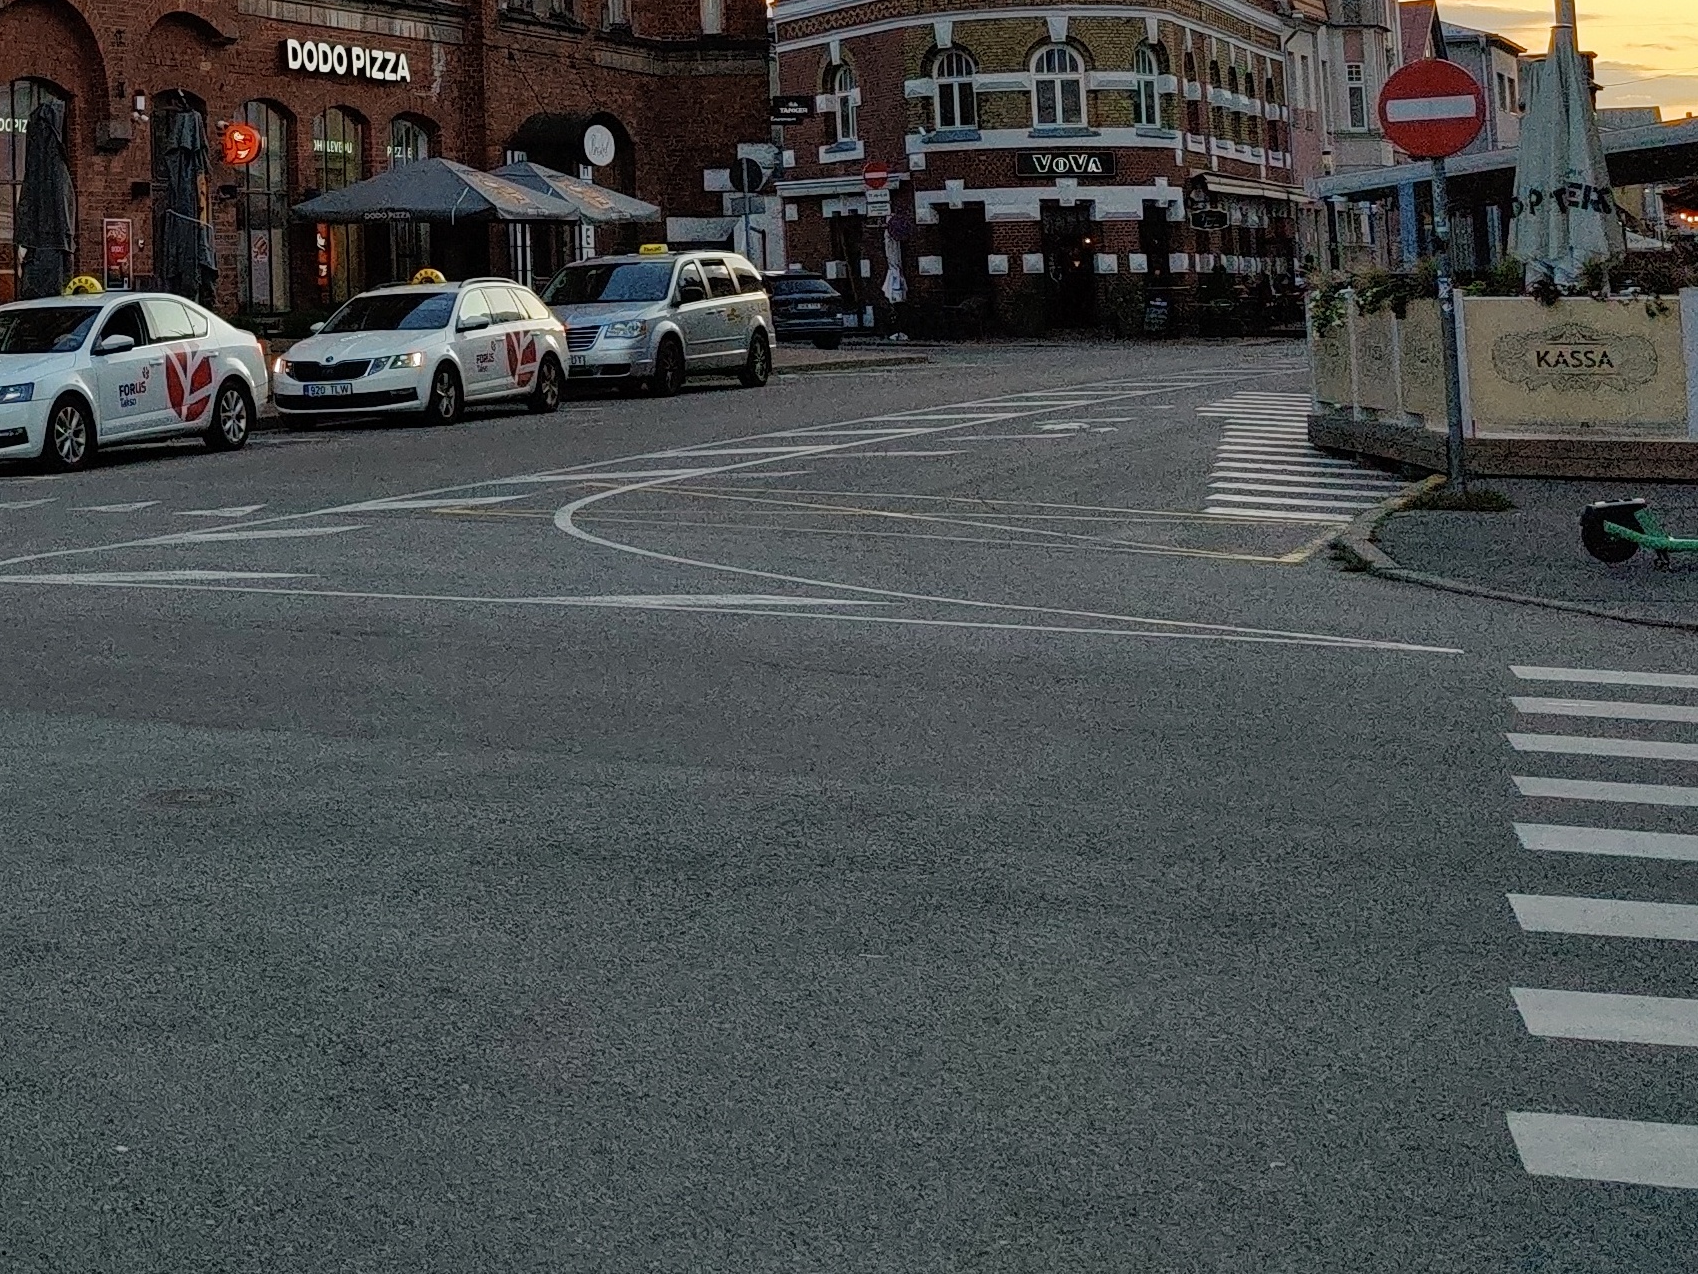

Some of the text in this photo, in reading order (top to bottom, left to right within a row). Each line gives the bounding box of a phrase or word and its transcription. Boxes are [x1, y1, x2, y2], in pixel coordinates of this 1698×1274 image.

[287, 38, 411, 83] DODO PIZZA
[67, 277, 95, 291] TAKSO
[1536, 350, 1615, 369] KASSA
[118, 380, 147, 398] FORUS
